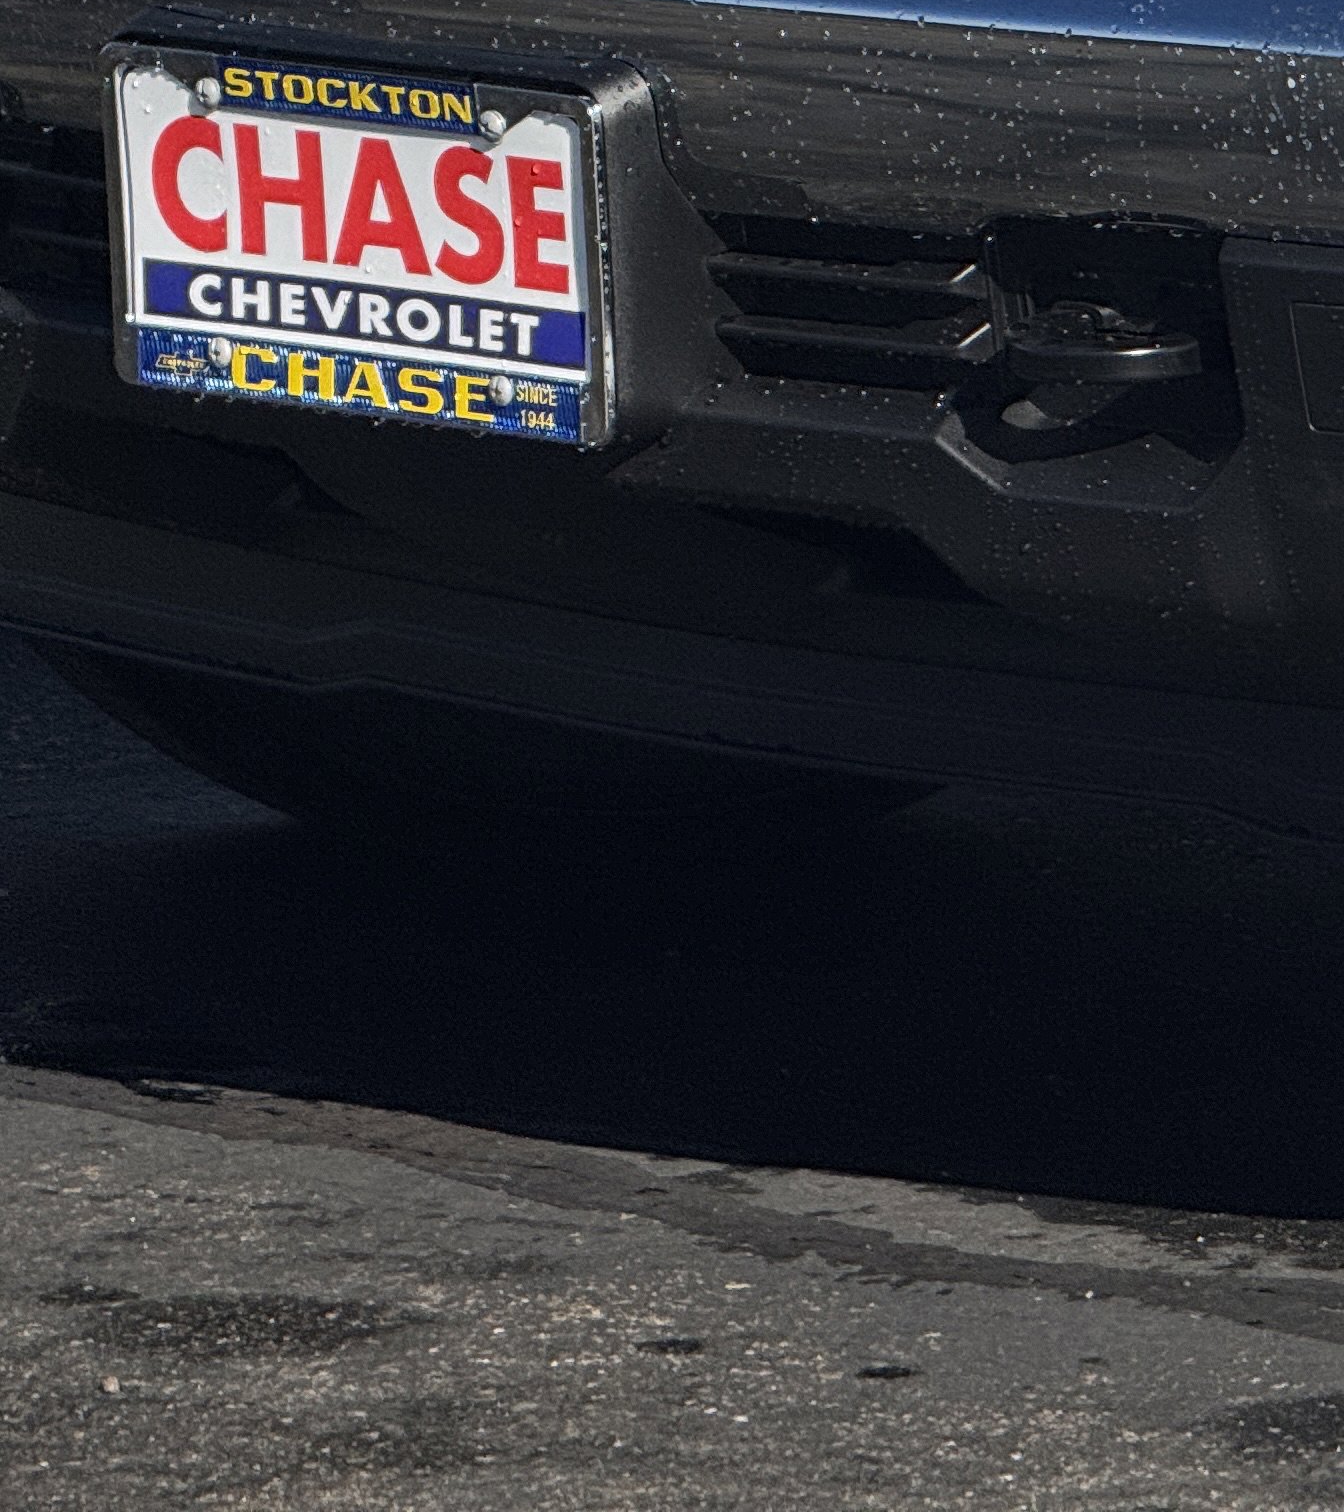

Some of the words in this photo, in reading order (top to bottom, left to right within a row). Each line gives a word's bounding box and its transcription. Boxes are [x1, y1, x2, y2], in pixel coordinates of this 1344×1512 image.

[225, 67, 473, 125] STOCKTON
[152, 115, 570, 295] CHASE
[188, 274, 540, 357] CHEVROLET
[231, 345, 496, 423] CHASE
[515, 383, 558, 407] SINCE
[521, 409, 556, 431] 1944
